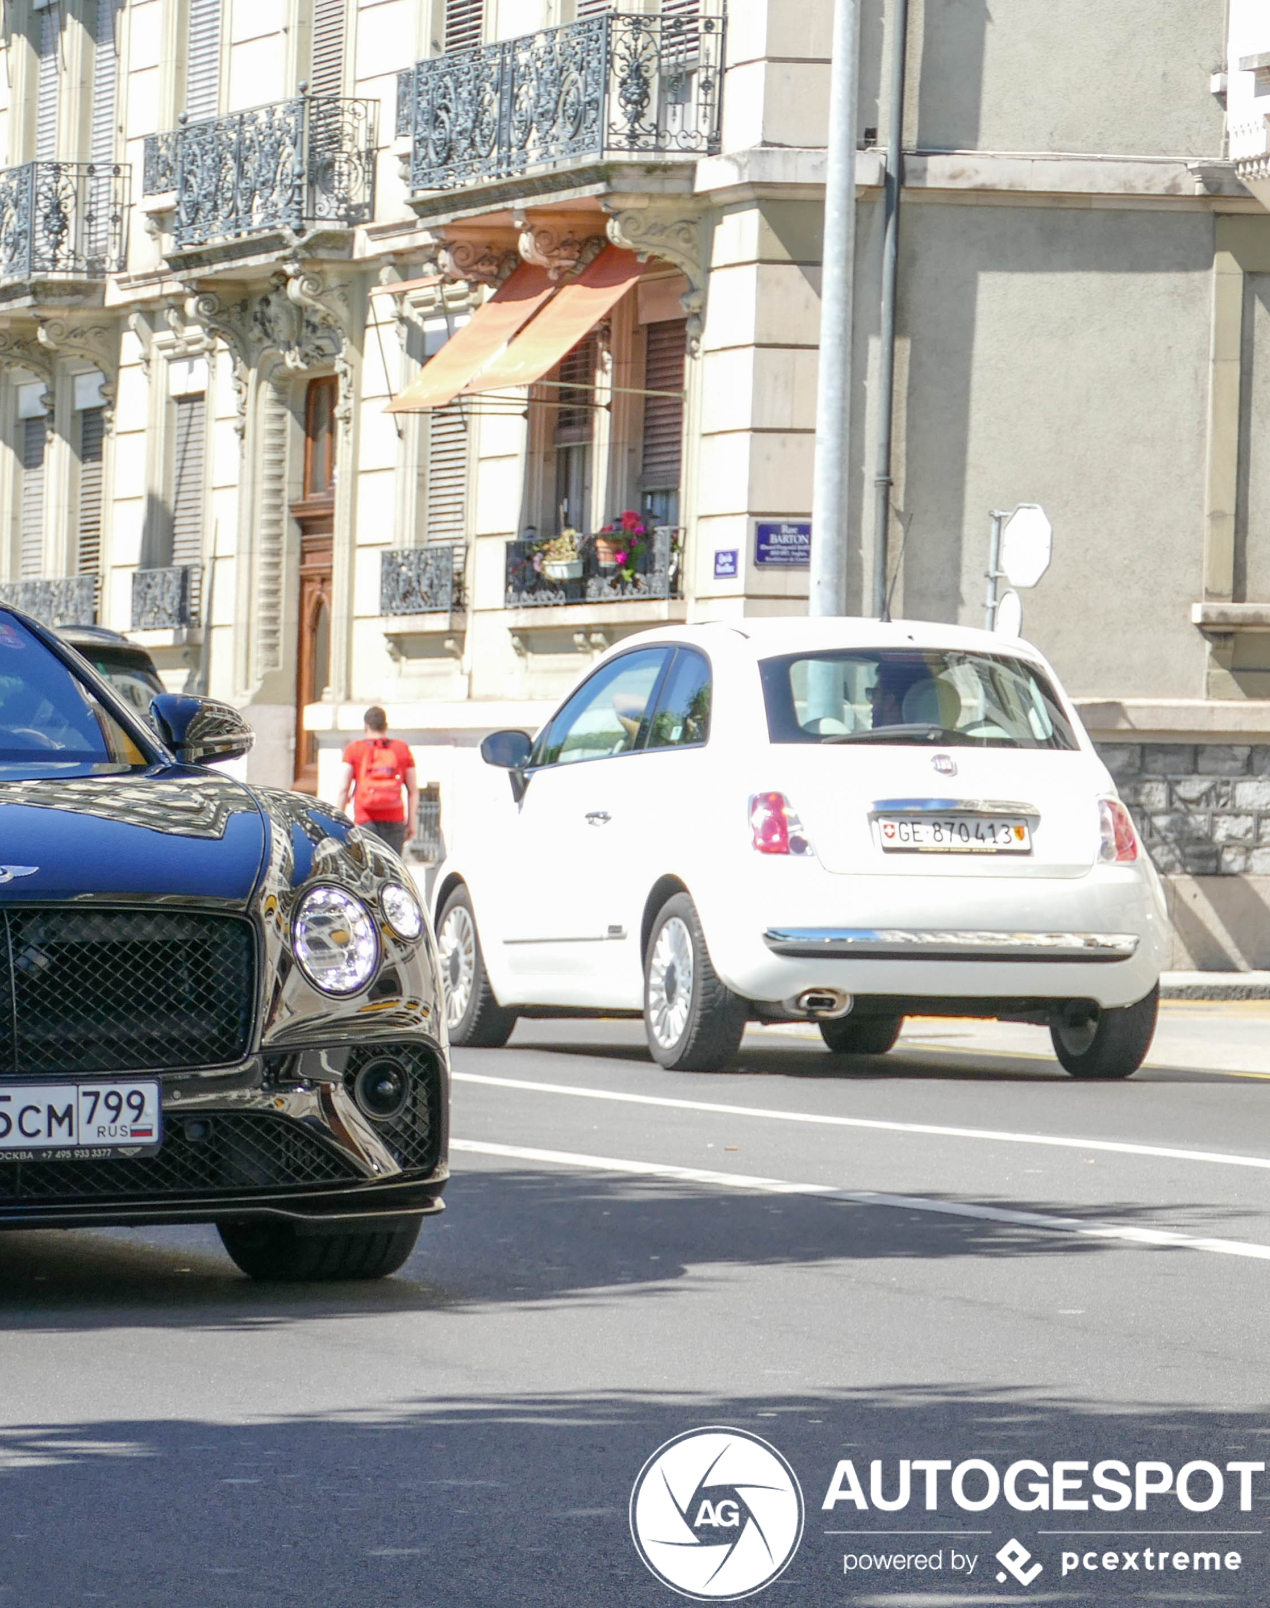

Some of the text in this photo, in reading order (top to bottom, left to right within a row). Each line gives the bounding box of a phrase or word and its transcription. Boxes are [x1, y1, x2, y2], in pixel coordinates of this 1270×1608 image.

[769, 534, 810, 544] BARTON
[81, 1089, 146, 1125] 799
[96, 1124, 129, 1138] RUS
[55, 1149, 72, 1159] 495
[74, 1149, 90, 1159] 933
[91, 1148, 112, 1158] 3377
